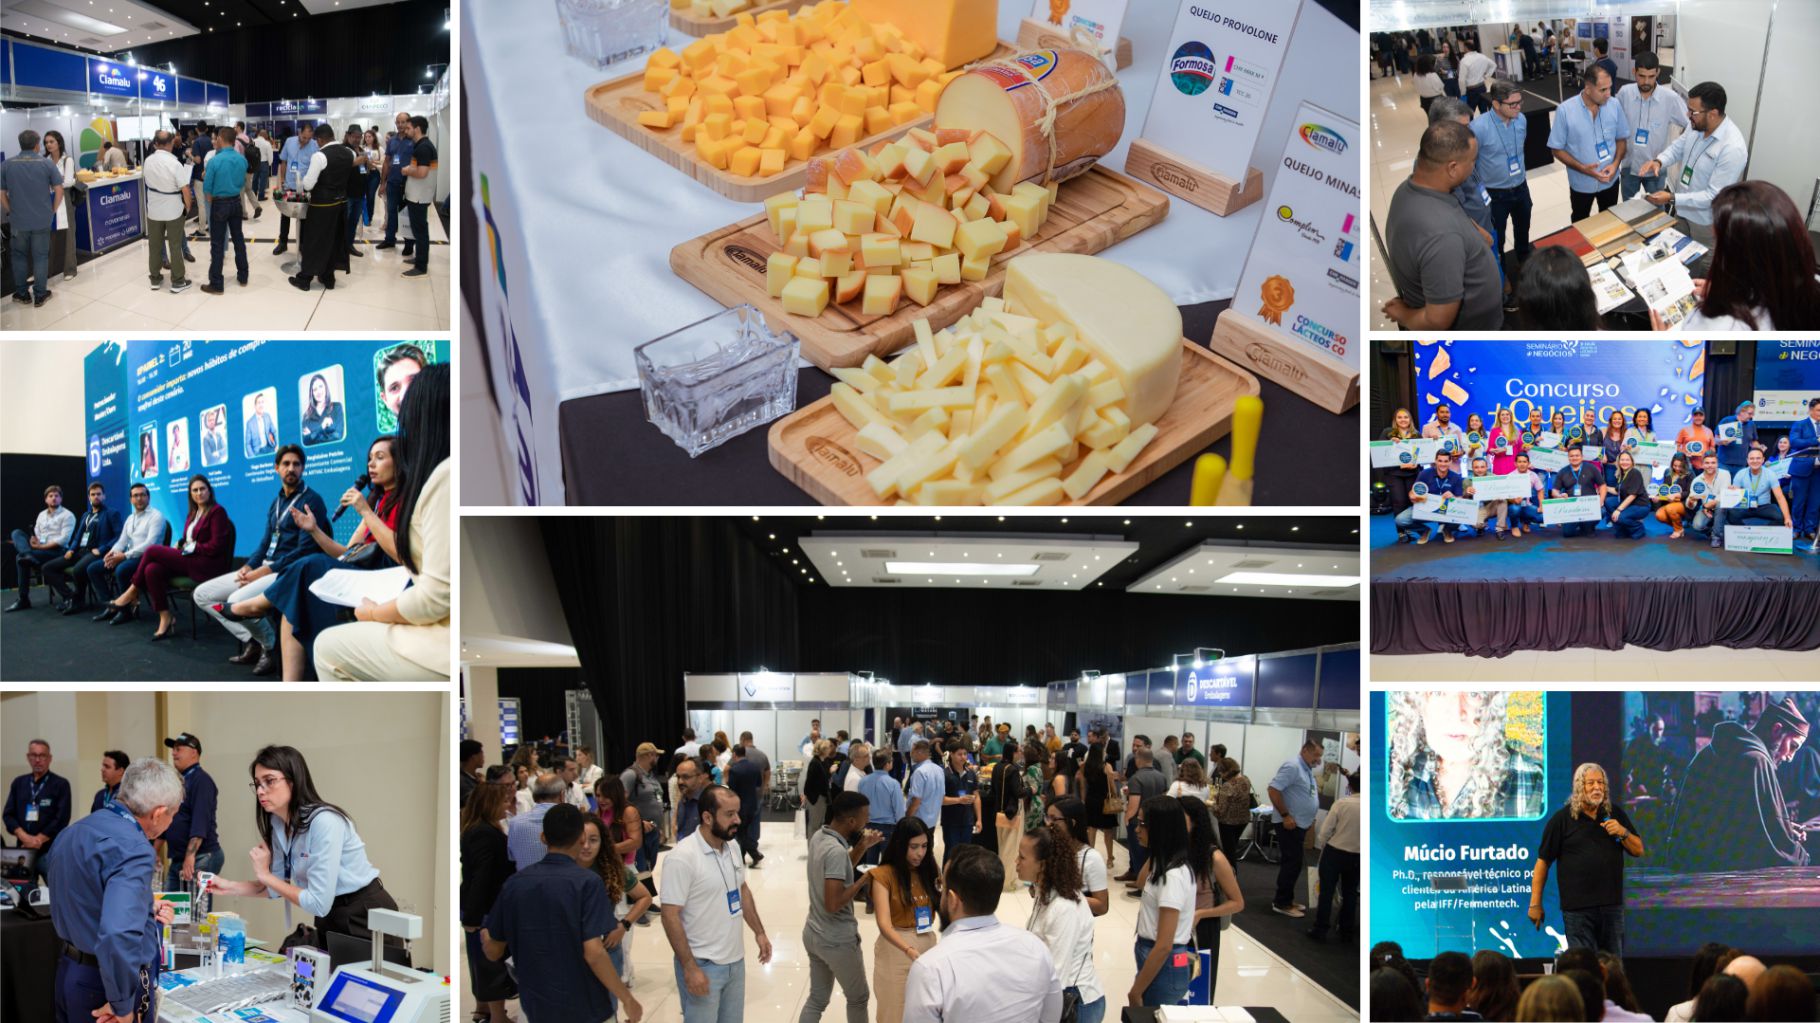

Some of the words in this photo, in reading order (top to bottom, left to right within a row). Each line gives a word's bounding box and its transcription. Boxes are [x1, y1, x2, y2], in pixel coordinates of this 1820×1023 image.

[1190, 5, 1221, 23] QUEIJO
[1222, 17, 1279, 44] PROVOLONE
[1173, 60, 1214, 75] Formosa
[99, 74, 131, 88] Clamalu
[1303, 126, 1346, 153] Clamalu
[1284, 157, 1323, 181] QUEIJO
[100, 191, 131, 205] Clamalu
[1297, 315, 1347, 345] CONCURSO
[1292, 322, 1331, 348] LÁCTEOS
[1332, 344, 1345, 356] CO
[1526, 342, 1562, 350] SEMINÁRIO
[1533, 349, 1573, 357] NEGÓCIOS
[1790, 350, 1820, 360] NEG
[1505, 378, 1620, 398] Concurso
[1404, 843, 1456, 861] Múcio
[1460, 843, 1529, 861] Furtado
[1392, 870, 1420, 882] Ph.D.,
[1484, 868, 1521, 880] técnico
[1501, 883, 1532, 894] Latina
[1414, 899, 1437, 911] pela
